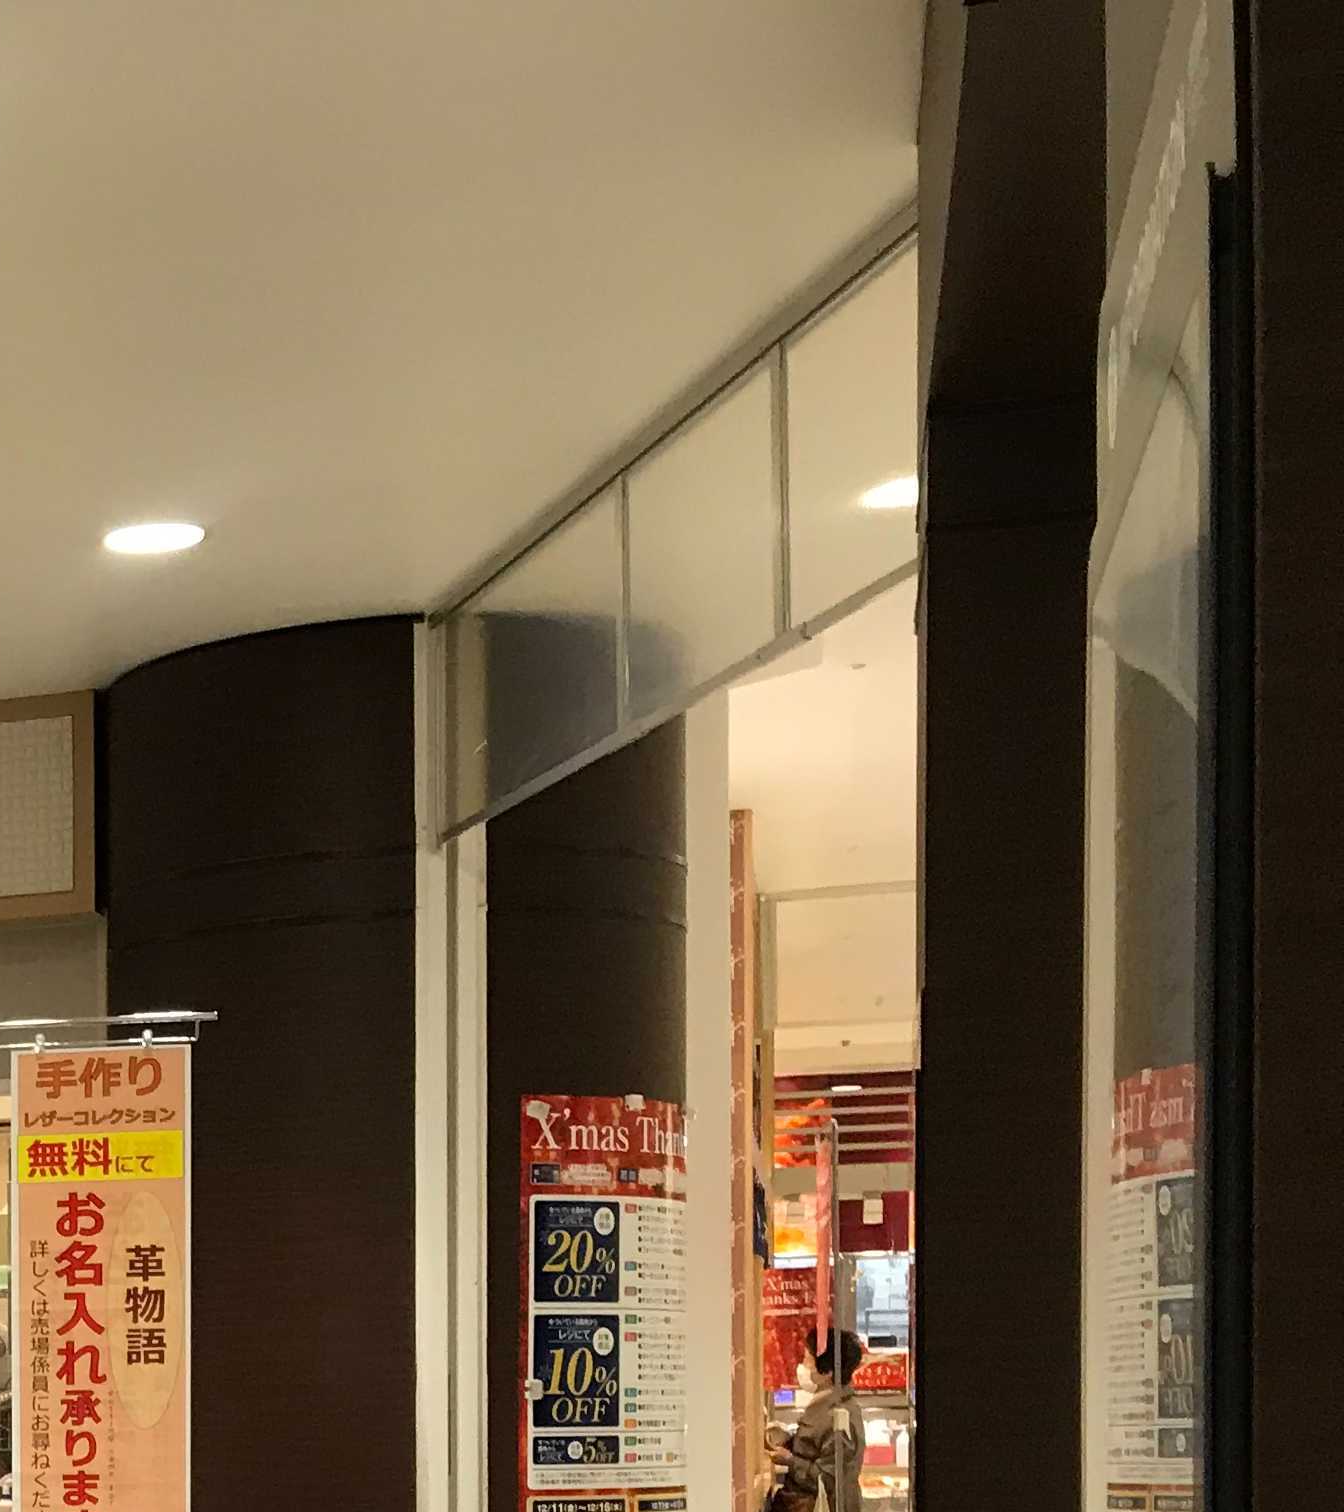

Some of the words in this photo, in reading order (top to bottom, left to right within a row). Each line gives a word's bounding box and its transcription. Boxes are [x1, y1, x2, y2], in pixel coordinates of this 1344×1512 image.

[36, 1056, 162, 1099] 手作り
[24, 1107, 176, 1128] レザーコレクション
[26, 1137, 155, 1178] 無料にて
[542, 1230, 615, 1274] 20%
[125, 1244, 166, 1365] 革物語
[554, 1275, 607, 1297] OFF
[544, 1347, 617, 1397] 10%
[552, 1398, 610, 1423] OFF
